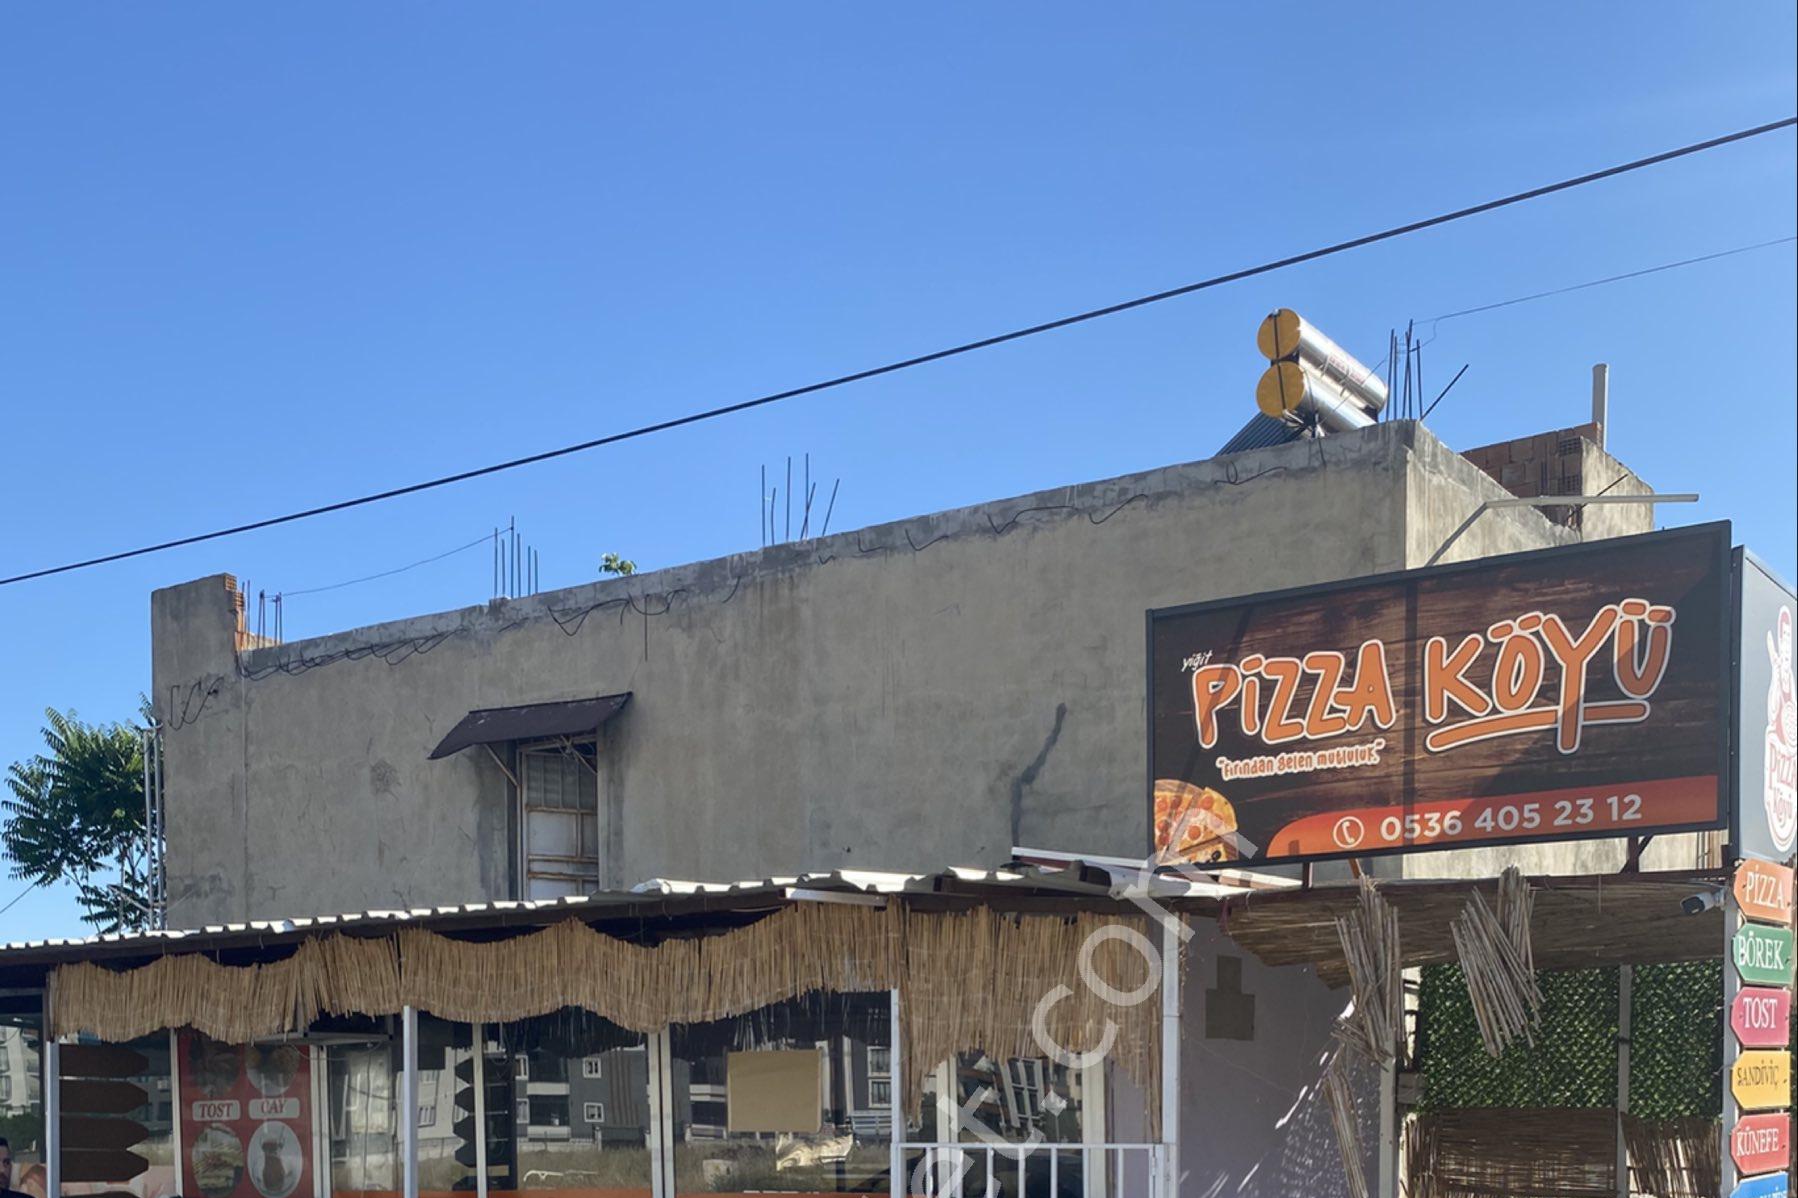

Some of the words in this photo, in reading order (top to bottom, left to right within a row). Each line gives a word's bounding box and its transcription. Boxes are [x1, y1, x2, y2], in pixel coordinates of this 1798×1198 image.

[1425, 598, 1676, 754] KÖYÜ
[1380, 810, 1463, 841] 0536
[1474, 803, 1541, 832] 405
[1553, 798, 1595, 826] 23
[1606, 794, 1642, 822] 12
[1745, 864, 1786, 910] PİZZA
[1738, 930, 1785, 970] BÖREK
[1743, 998, 1777, 1028] TOST
[200, 1103, 233, 1118] TOST
[1737, 1126, 1779, 1157] KÜNEFE
